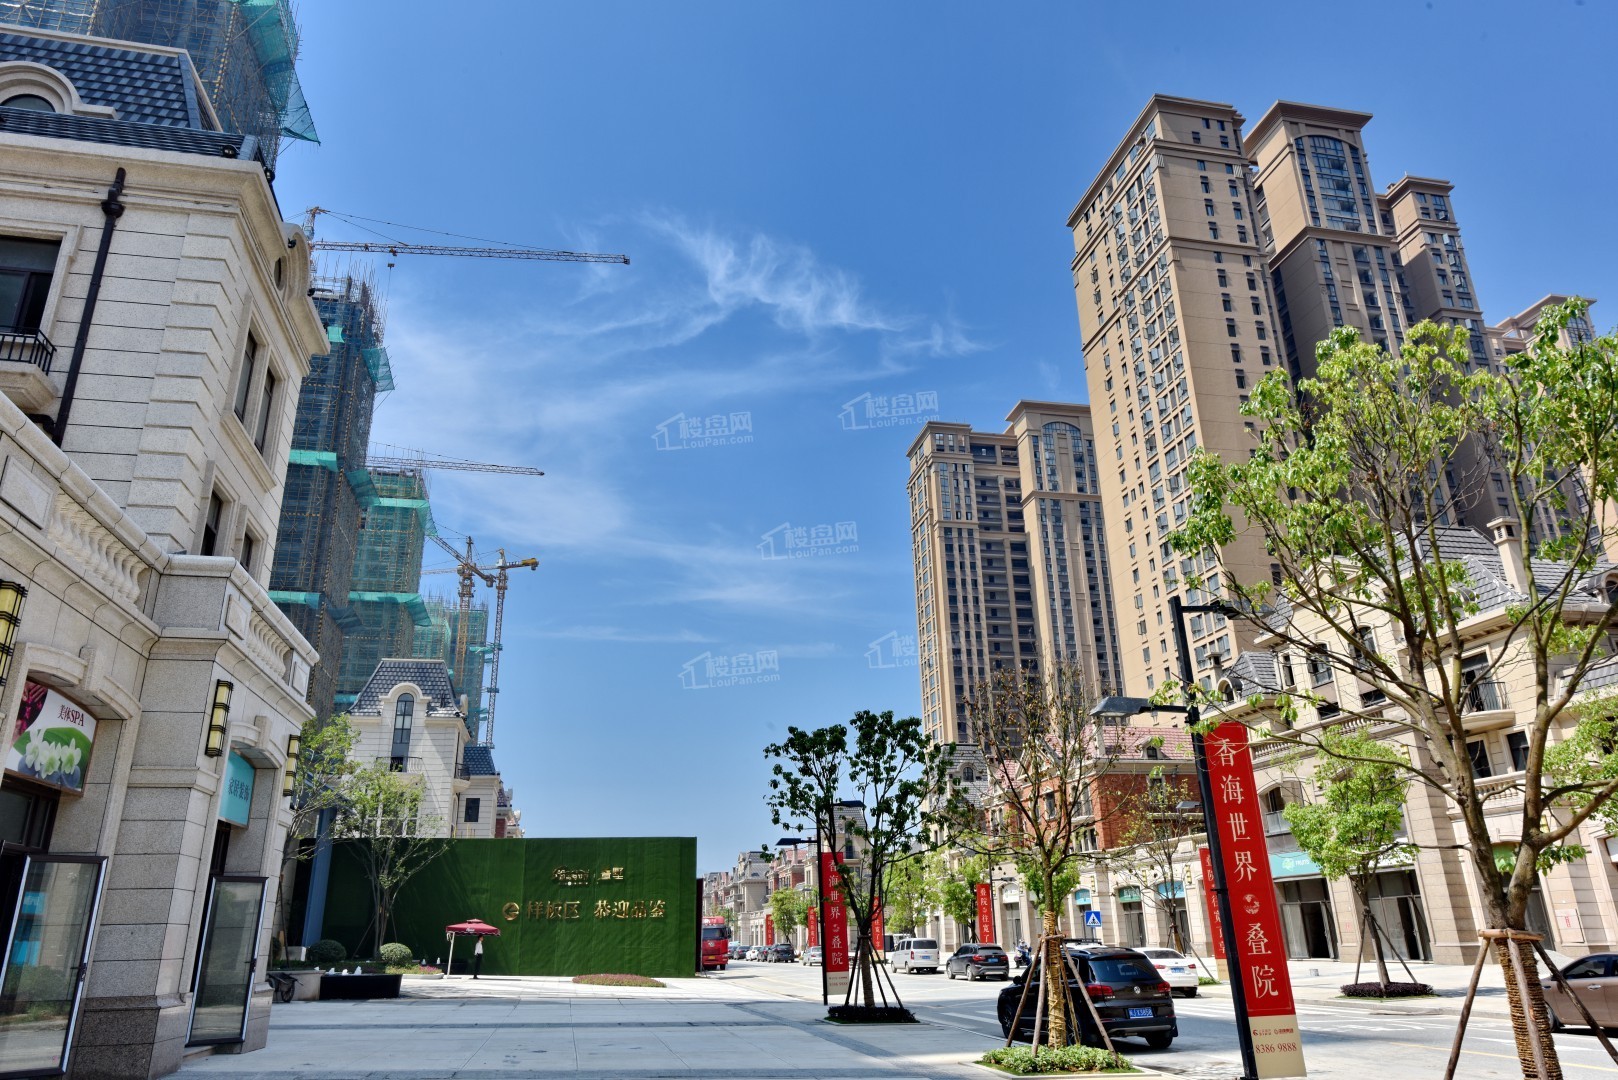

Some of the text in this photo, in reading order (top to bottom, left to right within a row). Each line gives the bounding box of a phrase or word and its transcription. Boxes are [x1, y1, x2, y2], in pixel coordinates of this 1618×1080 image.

[57, 704, 84, 727] 美体SPA
[1214, 738, 1279, 999] 香海世界 叠院
[526, 899, 666, 919] 样板区 恭迎品鉴
[831, 934, 844, 966] 叠院
[1255, 1041, 1298, 1054] 8386 9888
